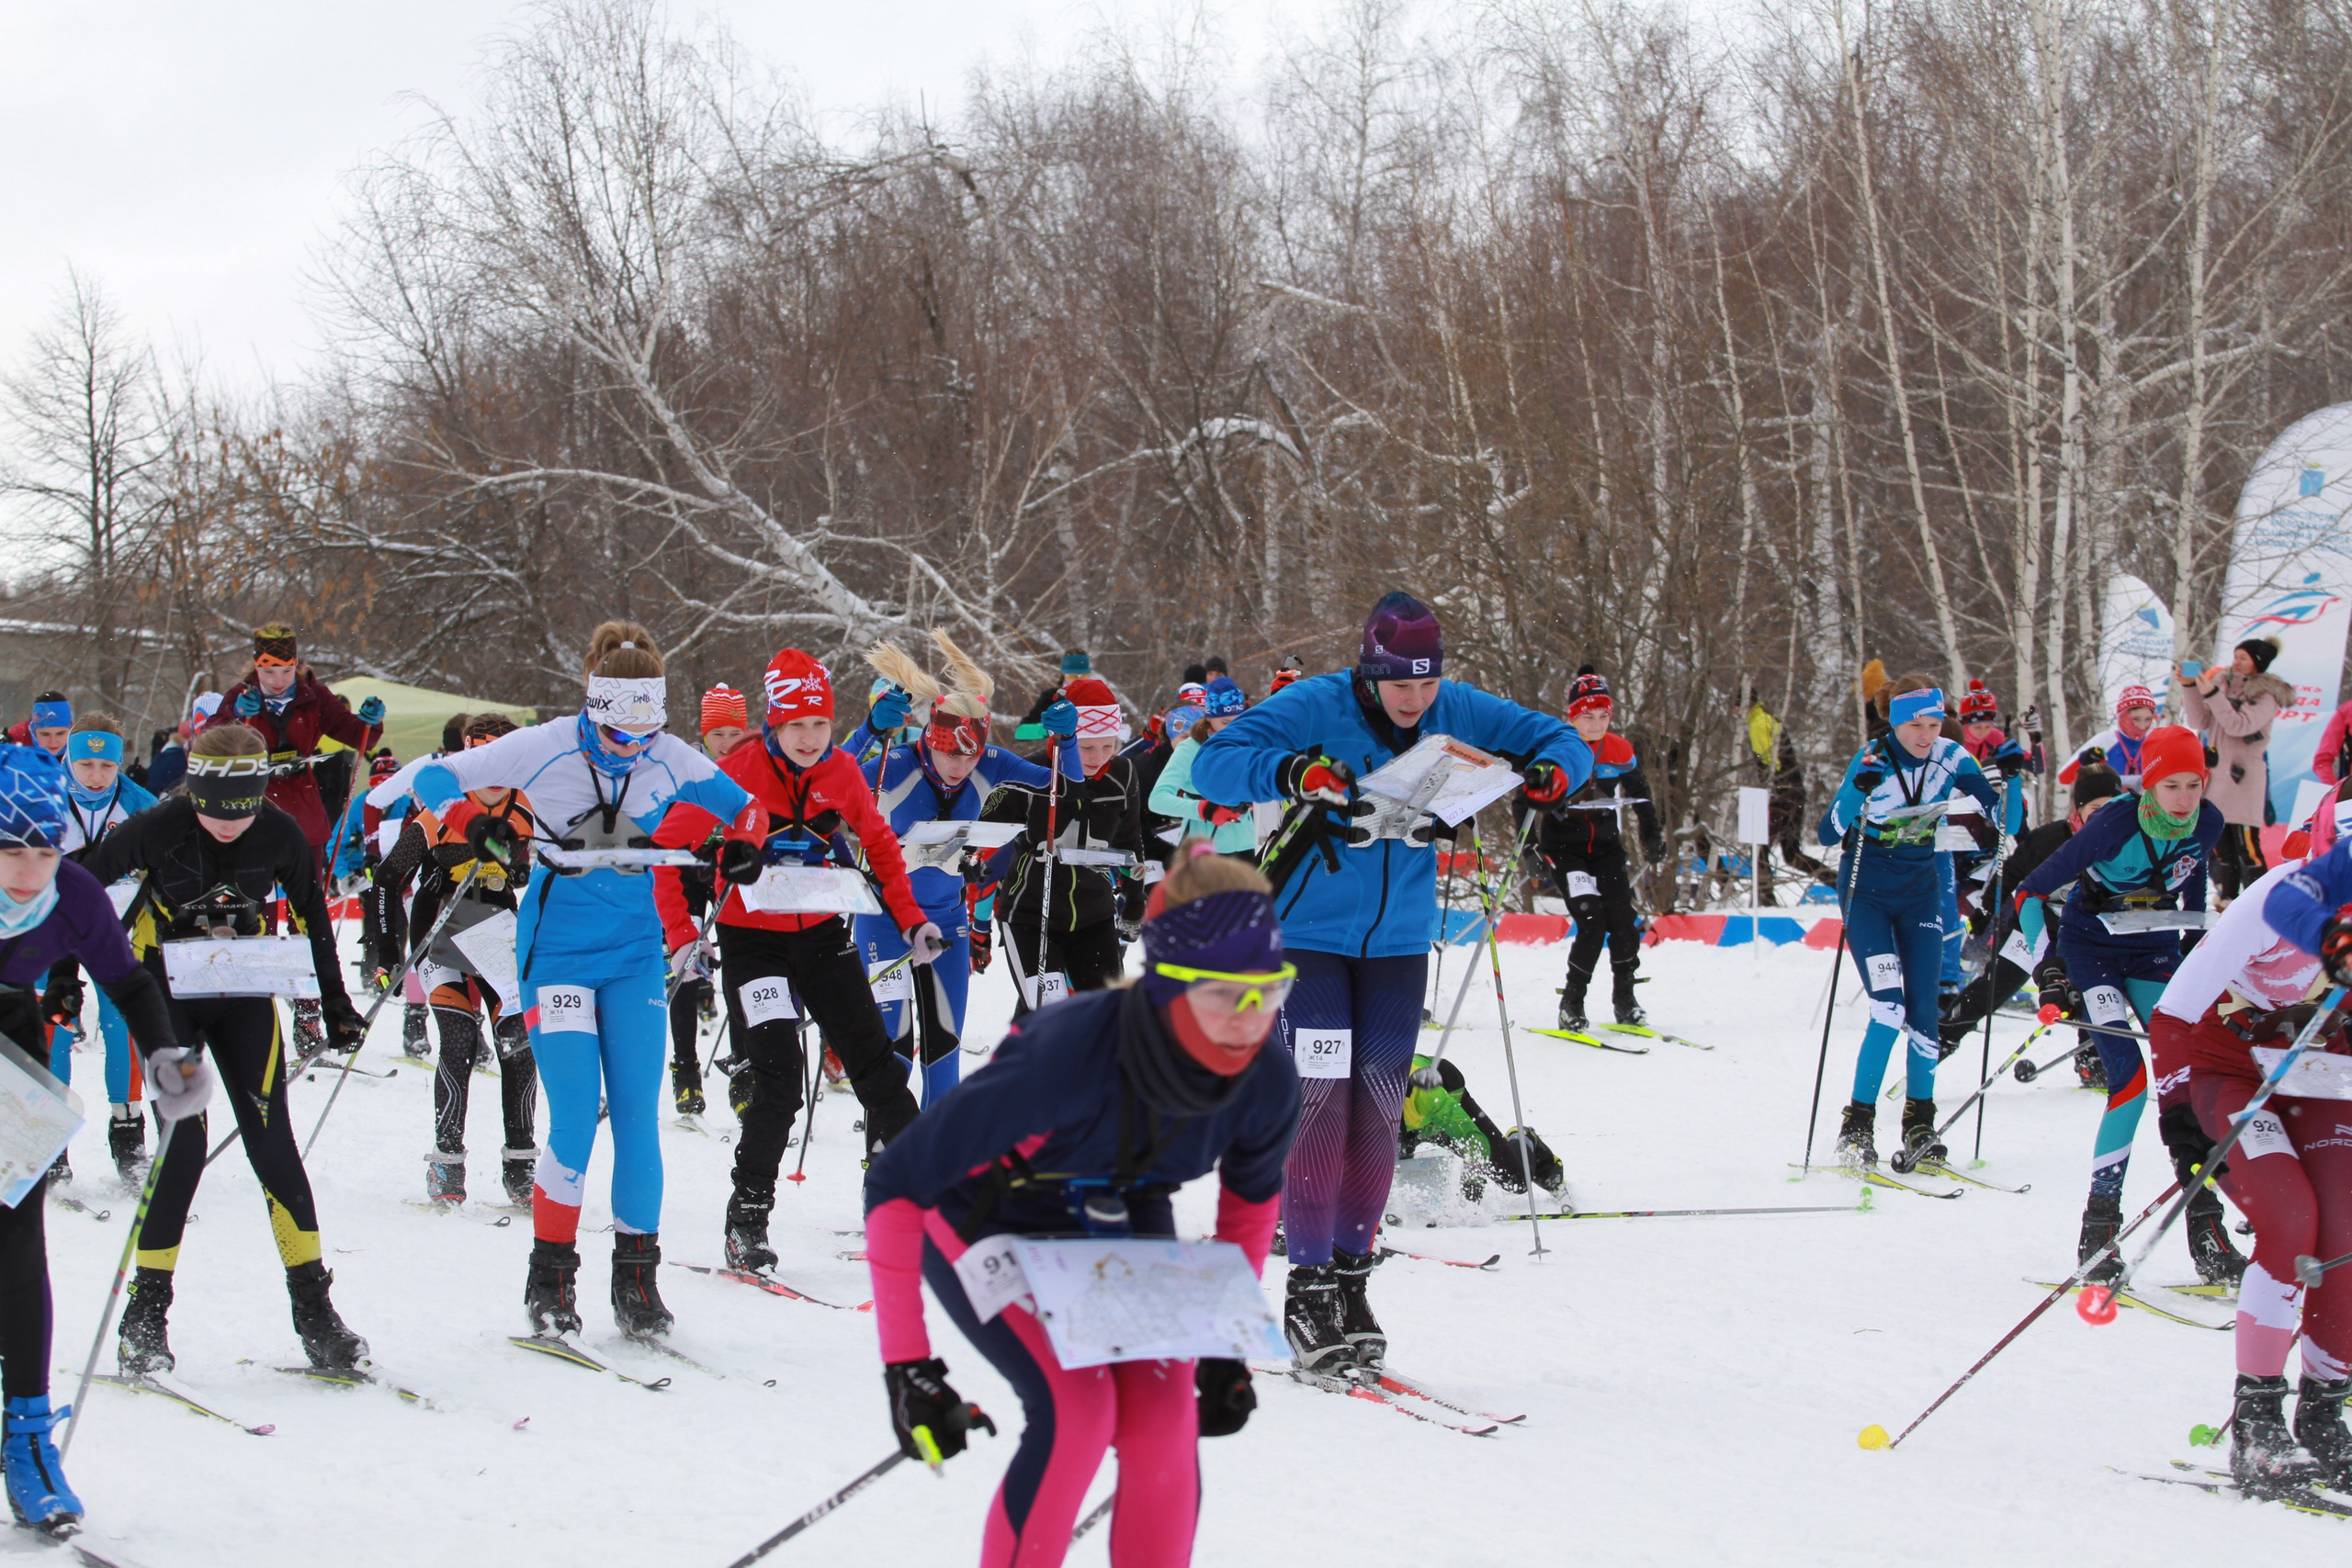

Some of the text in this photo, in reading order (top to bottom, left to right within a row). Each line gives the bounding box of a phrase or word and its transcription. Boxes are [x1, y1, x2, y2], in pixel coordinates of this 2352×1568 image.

[633, 694, 650, 705] DNB
[1849, 833, 1865, 888] NORDWAY
[1877, 962, 1897, 973] 944
[552, 994, 582, 1009] 929
[752, 987, 779, 1003] 928
[2097, 992, 2120, 1004] 915
[1313, 1039, 1341, 1055] 927
[1289, 1314, 1317, 1345] MADSHUS
